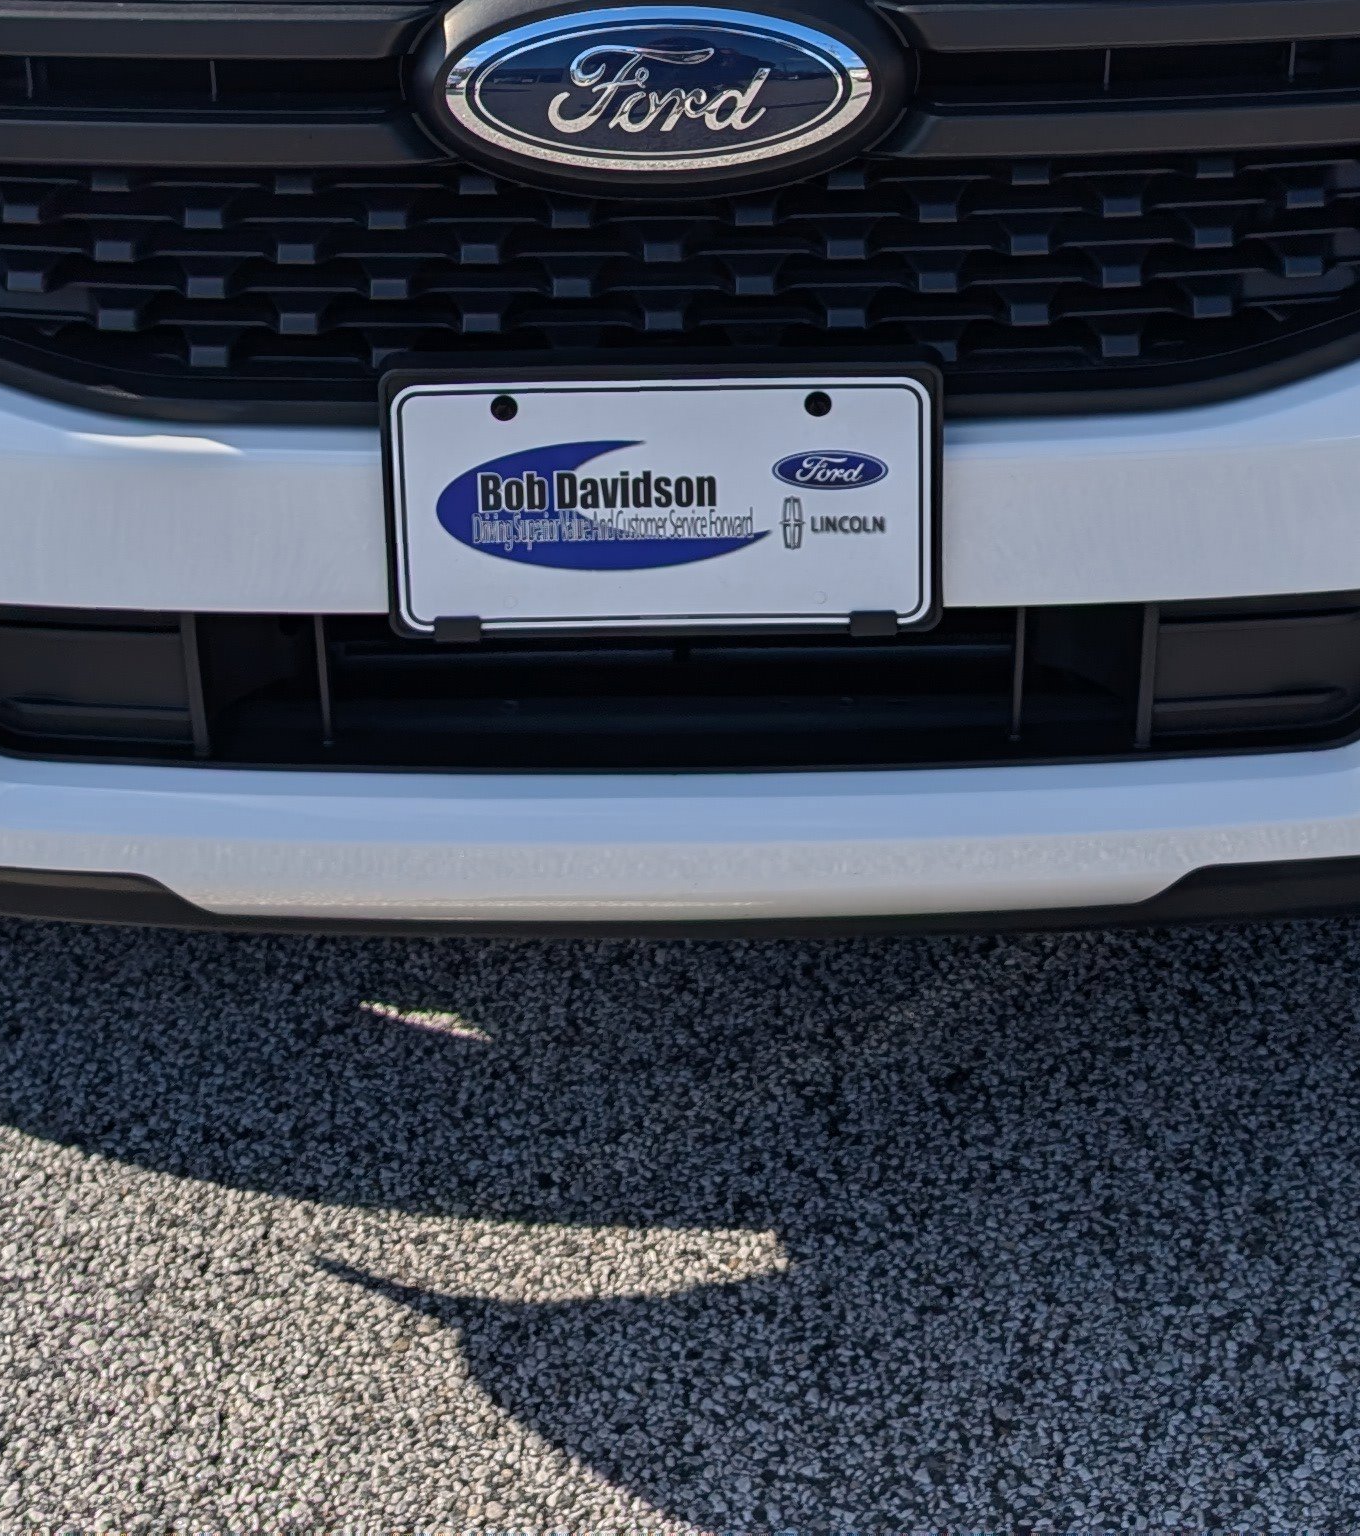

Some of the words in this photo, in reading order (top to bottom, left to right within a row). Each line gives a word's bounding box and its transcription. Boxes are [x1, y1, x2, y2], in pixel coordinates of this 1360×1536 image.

[547, 44, 772, 134] Ford
[795, 455, 865, 482] Ford
[478, 470, 547, 513] Bob
[555, 469, 718, 510] Davidson
[472, 512, 513, 551] Driving
[513, 512, 559, 550] Superior
[560, 510, 590, 541] Value
[591, 508, 614, 541] And
[616, 508, 667, 540] Customer
[669, 508, 707, 539] Service
[709, 506, 754, 539] Forward
[810, 515, 886, 533] LINCOLN
